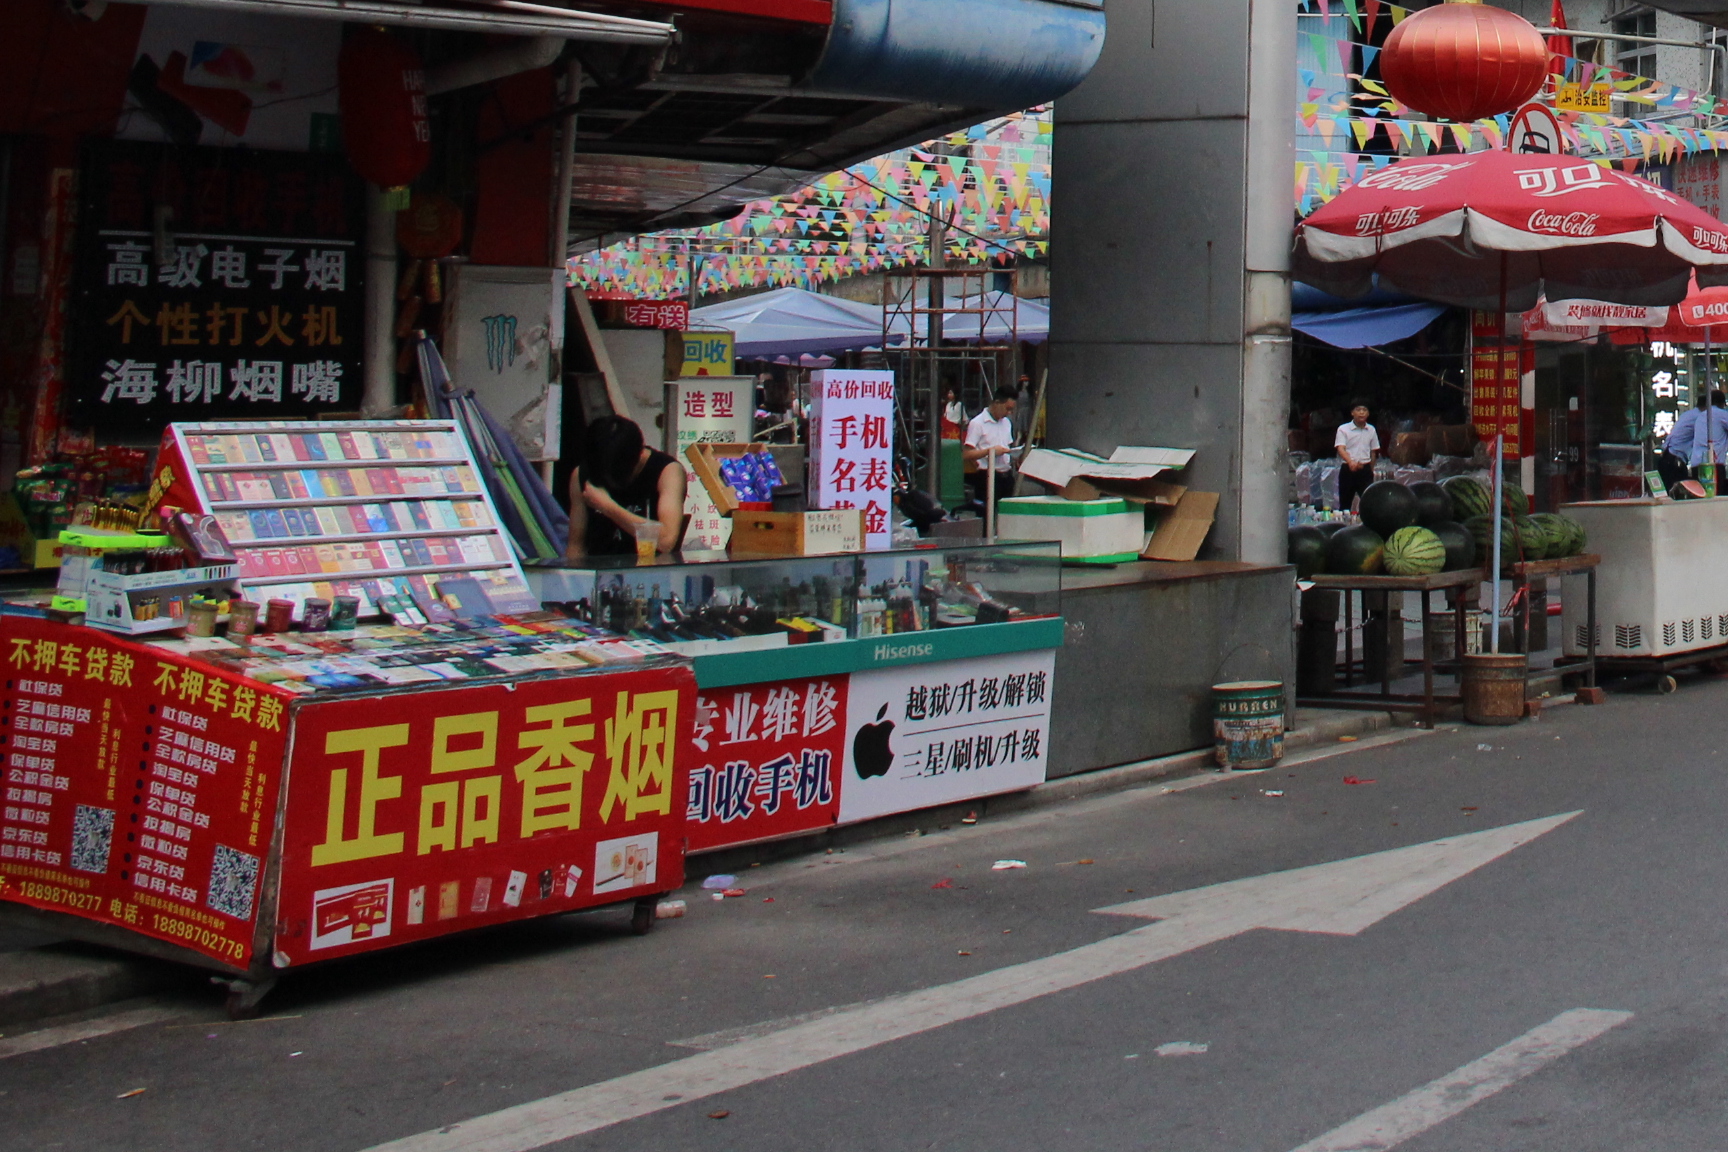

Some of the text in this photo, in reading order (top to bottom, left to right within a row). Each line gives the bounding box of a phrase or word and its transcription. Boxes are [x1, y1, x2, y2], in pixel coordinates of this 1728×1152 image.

[107, 242, 346, 291] 高级电子烟
[107, 299, 343, 347] 个性打火机
[626, 304, 686, 328] 有送
[683, 340, 727, 363] 回收
[100, 358, 343, 404] 海柳烟嘴
[827, 379, 894, 399] 高价回收
[684, 391, 733, 418] 造型
[830, 413, 889, 450] 手机
[830, 458, 888, 493] 名表
[9, 638, 134, 687] 不押车贷款
[874, 643, 934, 662] Hisense
[18, 678, 63, 697] 社保贷
[153, 661, 284, 733] 不押车贷款
[904, 670, 1046, 723] 越狱/升级/解锁
[16, 699, 91, 723] 芝麻信用贷
[161, 705, 208, 731] 社保贷
[691, 680, 839, 752] 专业维修
[14, 716, 74, 736] 全款房贷
[12, 734, 57, 753] 淘宝贷
[158, 726, 236, 764] 芝麻信用贷
[900, 728, 1041, 780] 三星/刷机/升级
[10, 753, 55, 772] 保单贷
[155, 743, 217, 775] 全款房贷
[9, 771, 70, 791] 公积金贷
[152, 762, 199, 788] 淘宝贷
[311, 689, 679, 868] 正品香烟
[686, 748, 832, 824] 回收手机
[149, 781, 196, 807] 保单贷
[147, 798, 210, 828] 公积金贷
[2, 827, 48, 846] 京东贷
[0, 844, 62, 866] 信用卡贷
[137, 854, 184, 881] 京东贷
[134, 872, 198, 903] 信用卡贷
[152, 914, 244, 960] 18898702778
